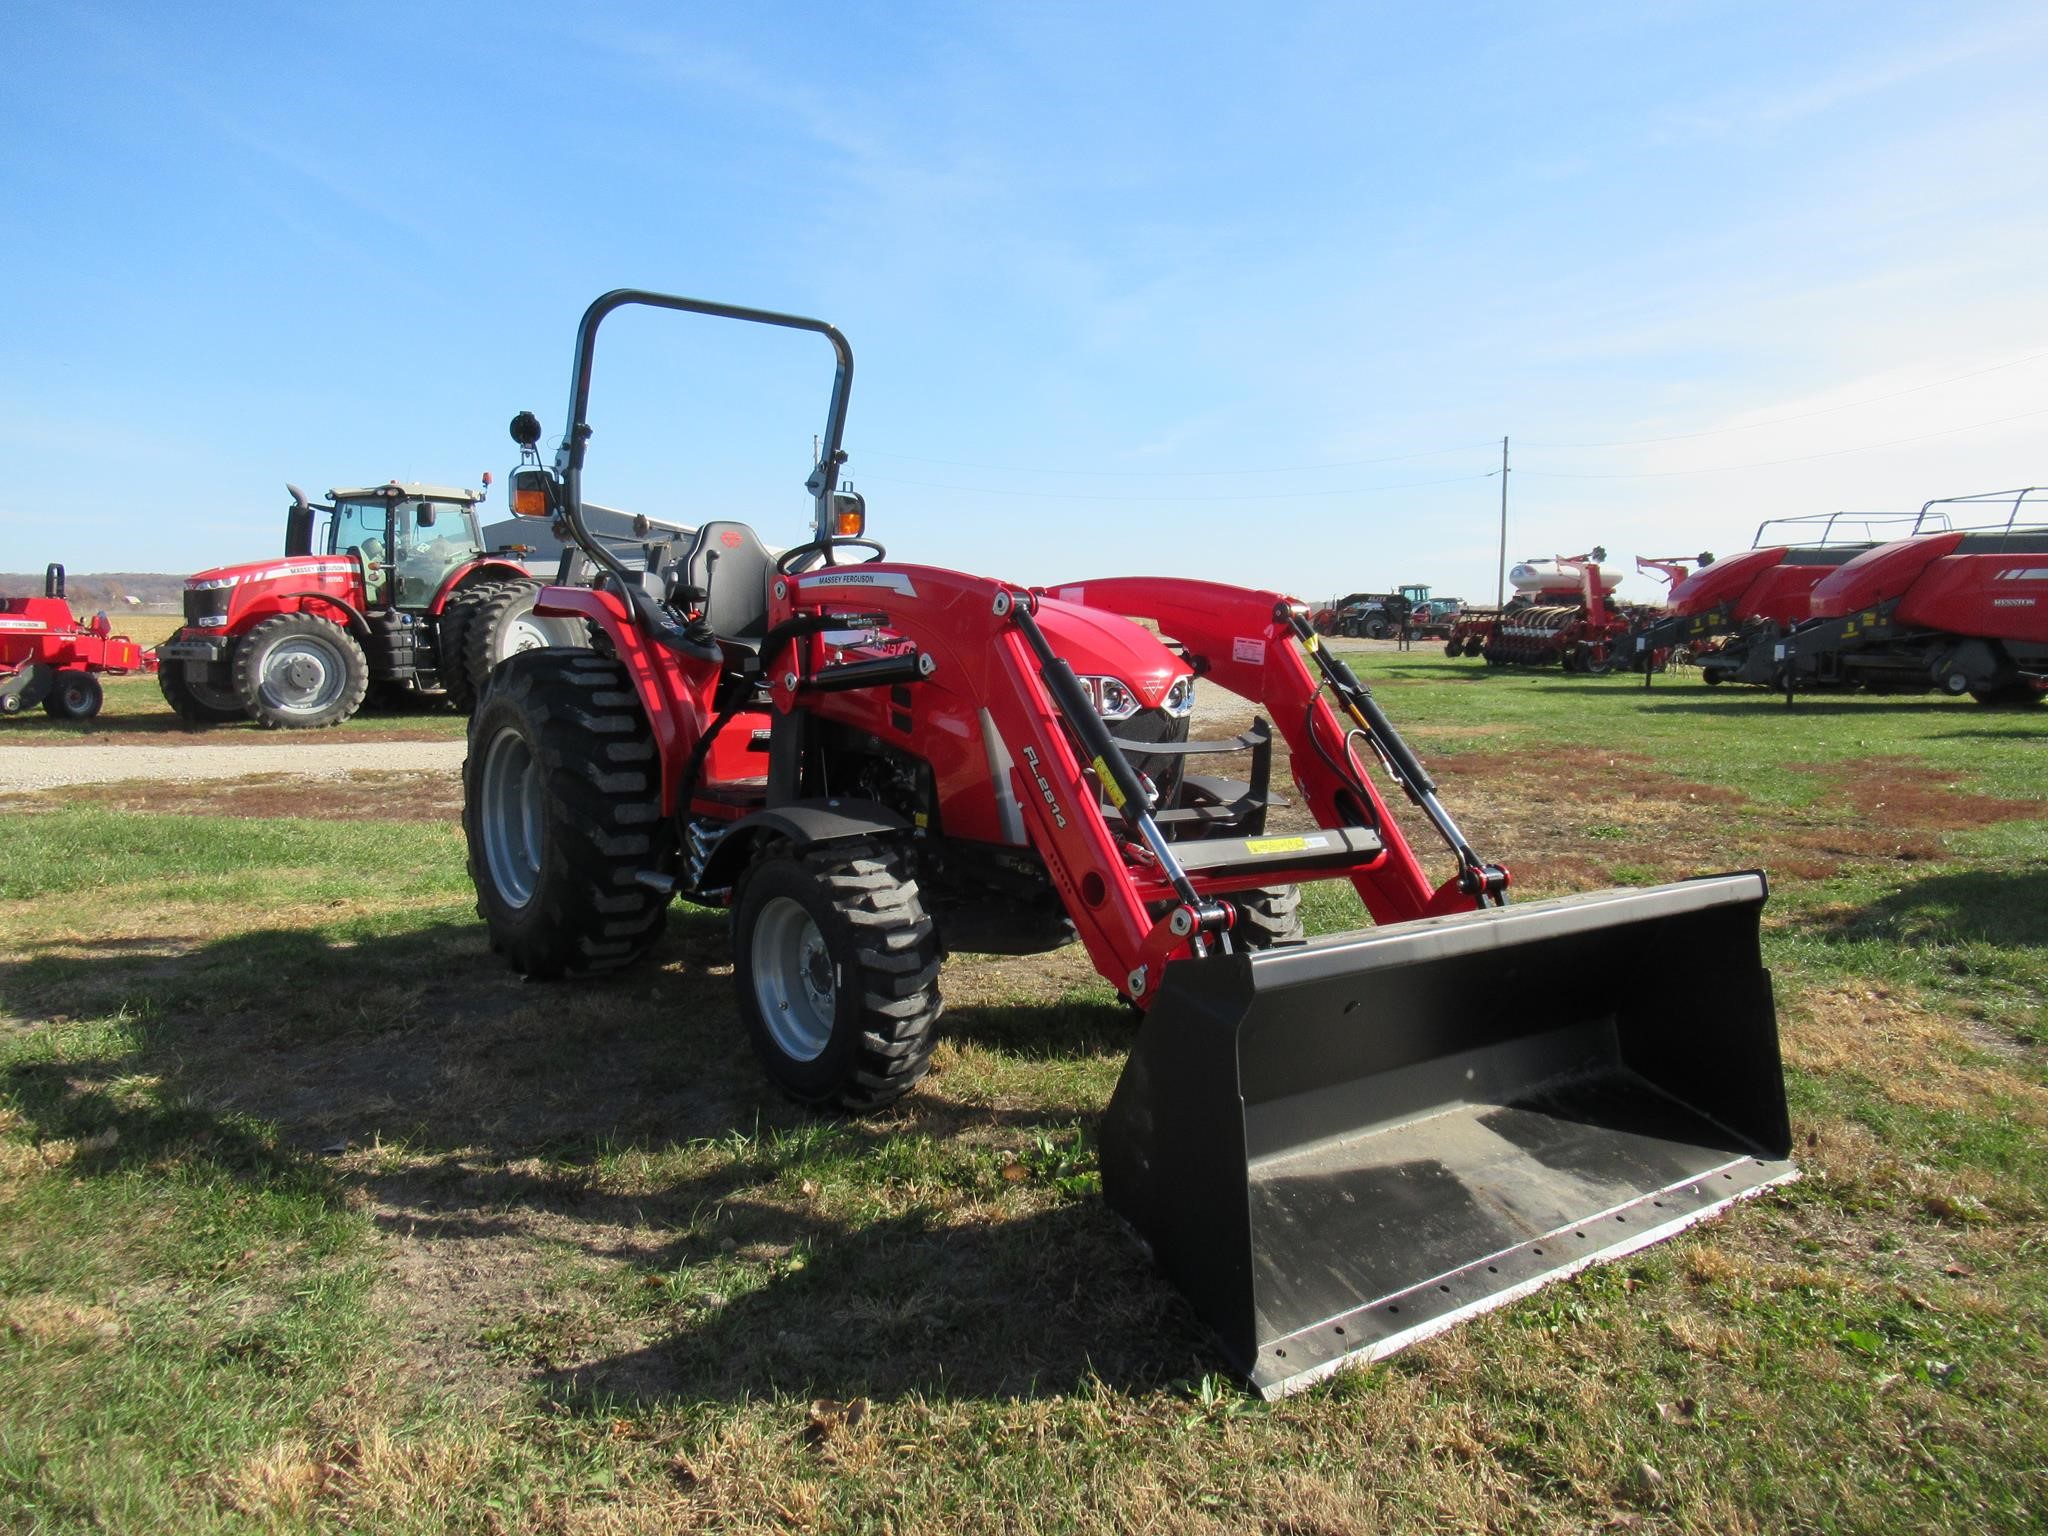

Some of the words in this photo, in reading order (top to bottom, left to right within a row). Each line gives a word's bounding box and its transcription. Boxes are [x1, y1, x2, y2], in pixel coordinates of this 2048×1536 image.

[819, 576, 842, 584] MASSEY
[843, 575, 874, 583] FERGUSON
[1023, 746, 1067, 829] FL.2814
